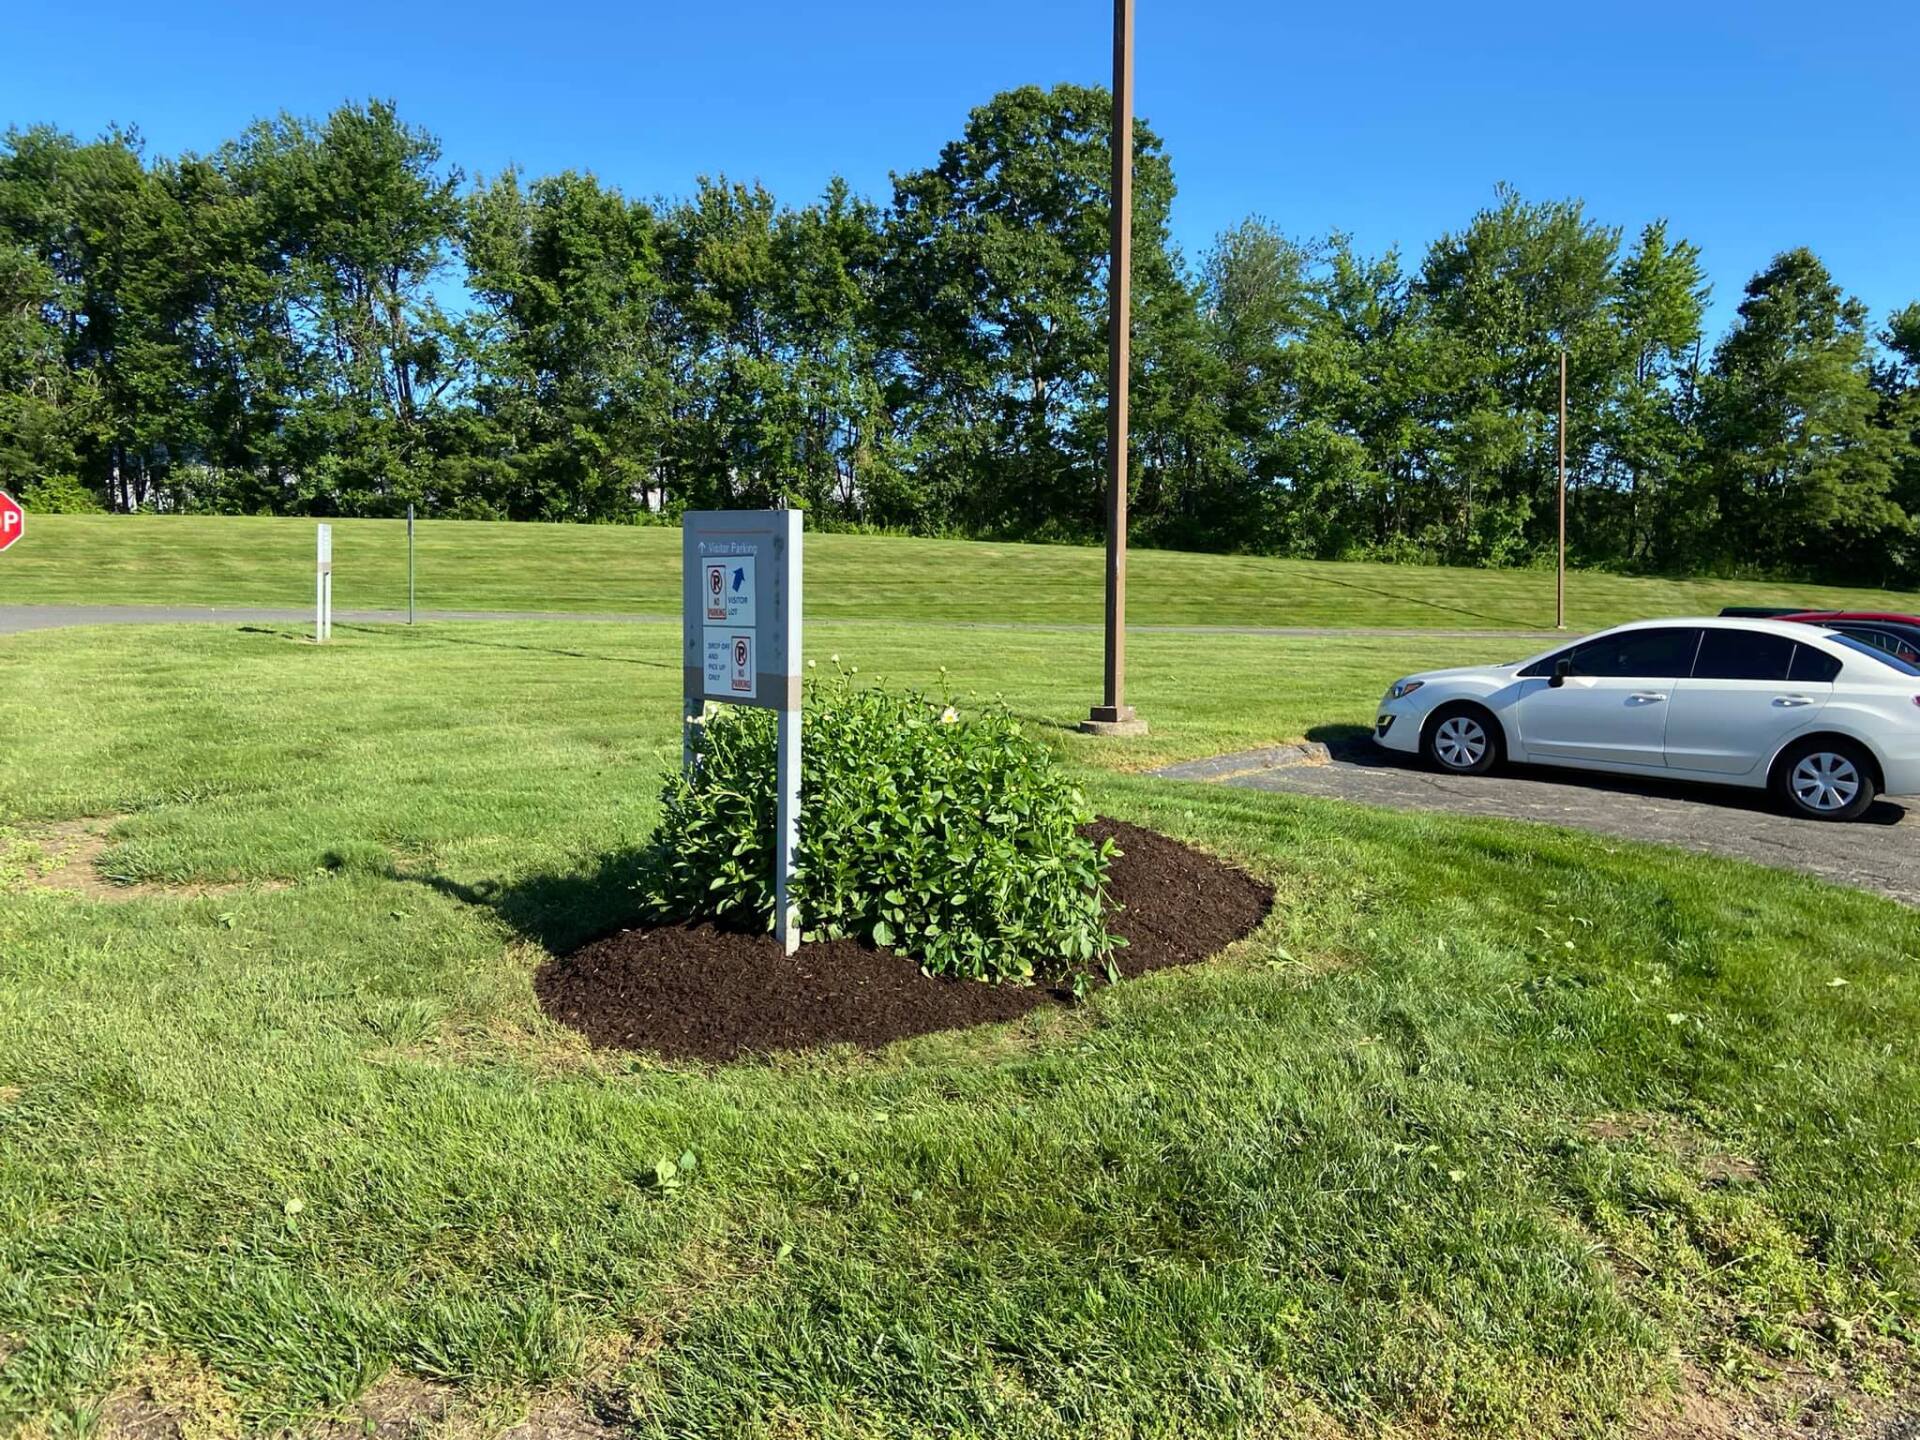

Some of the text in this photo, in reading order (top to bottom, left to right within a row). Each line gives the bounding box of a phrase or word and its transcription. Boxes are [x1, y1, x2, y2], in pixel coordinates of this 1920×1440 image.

[708, 542, 758, 555] Visitor Parking
[728, 596, 748, 604] VISITOR
[708, 608, 727, 617] PARKING
[728, 608, 738, 616] LOT
[732, 680, 752, 688] PARKING
